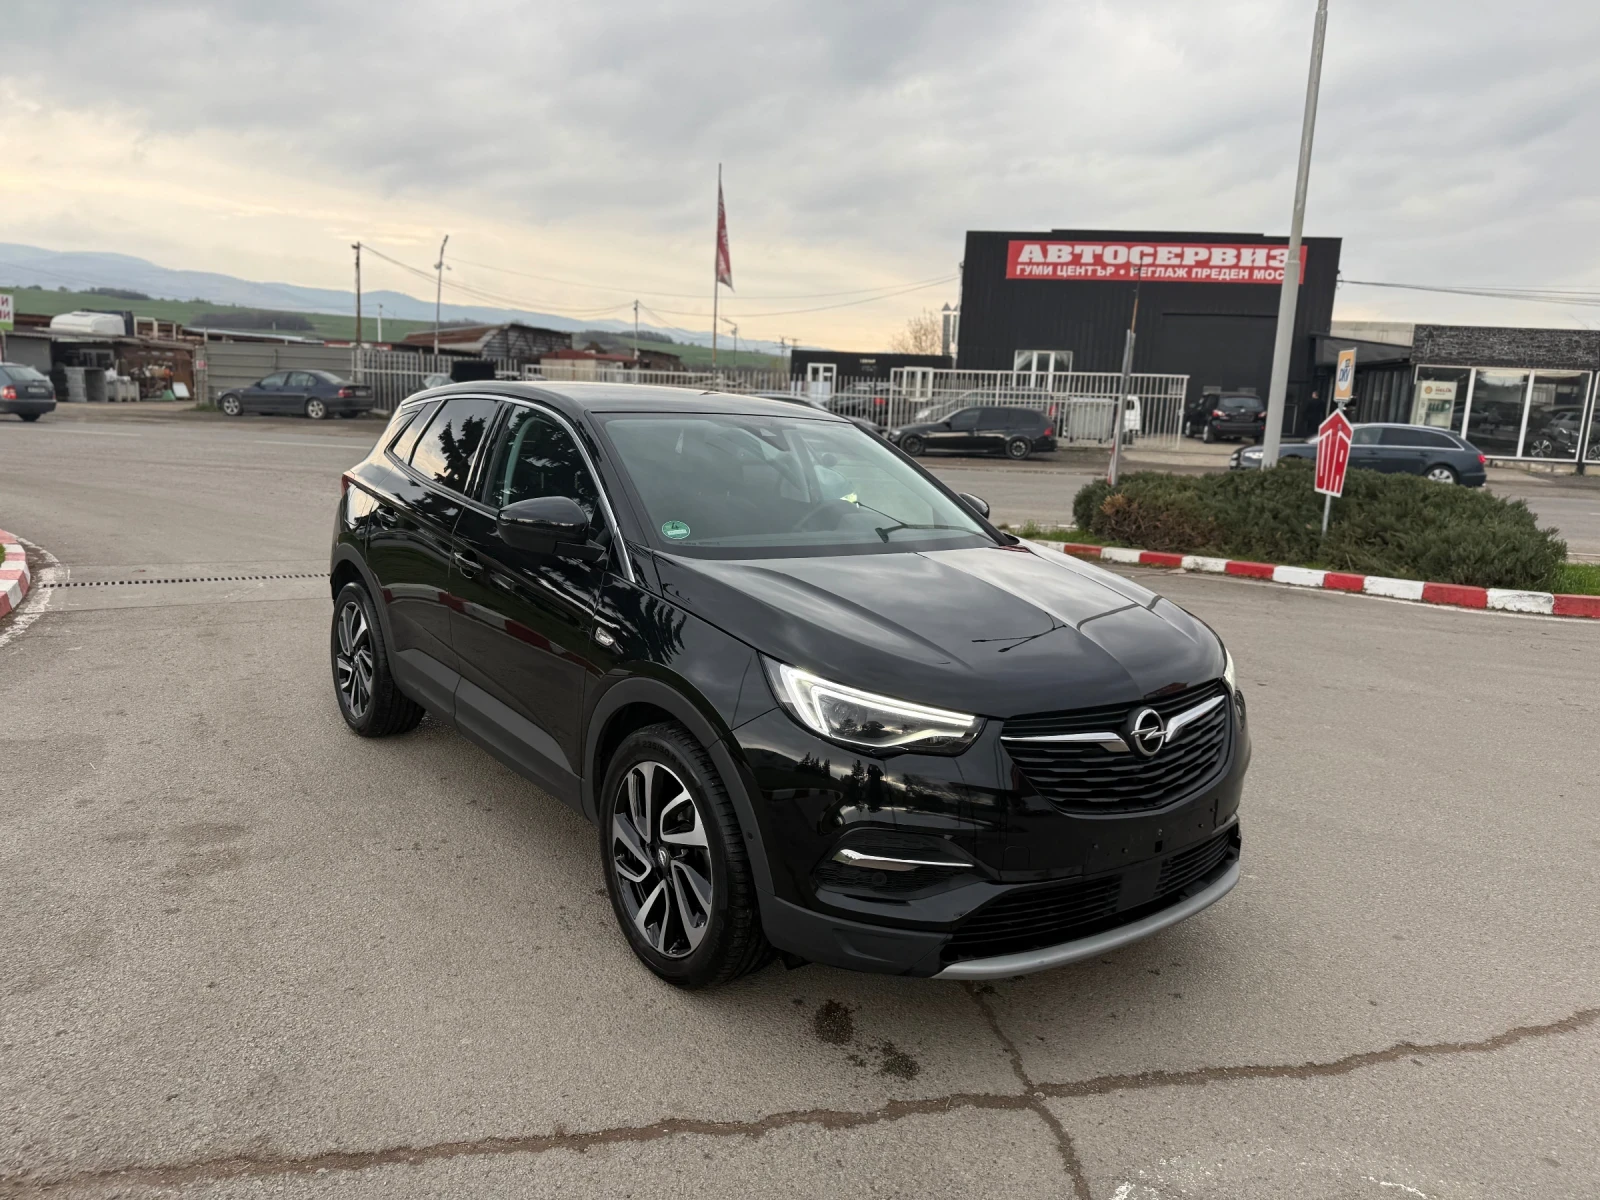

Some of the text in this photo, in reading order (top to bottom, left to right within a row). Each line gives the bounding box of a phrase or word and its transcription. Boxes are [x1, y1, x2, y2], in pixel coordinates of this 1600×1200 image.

[1017, 244, 1289, 267] АВТОСЕРВИЗ
[1016, 265, 1051, 275] ГУМИ
[1056, 265, 1115, 277] ЦЕНТЪР
[1191, 268, 1249, 280] ПРЕДЕН
[1253, 269, 1286, 281] МОС
